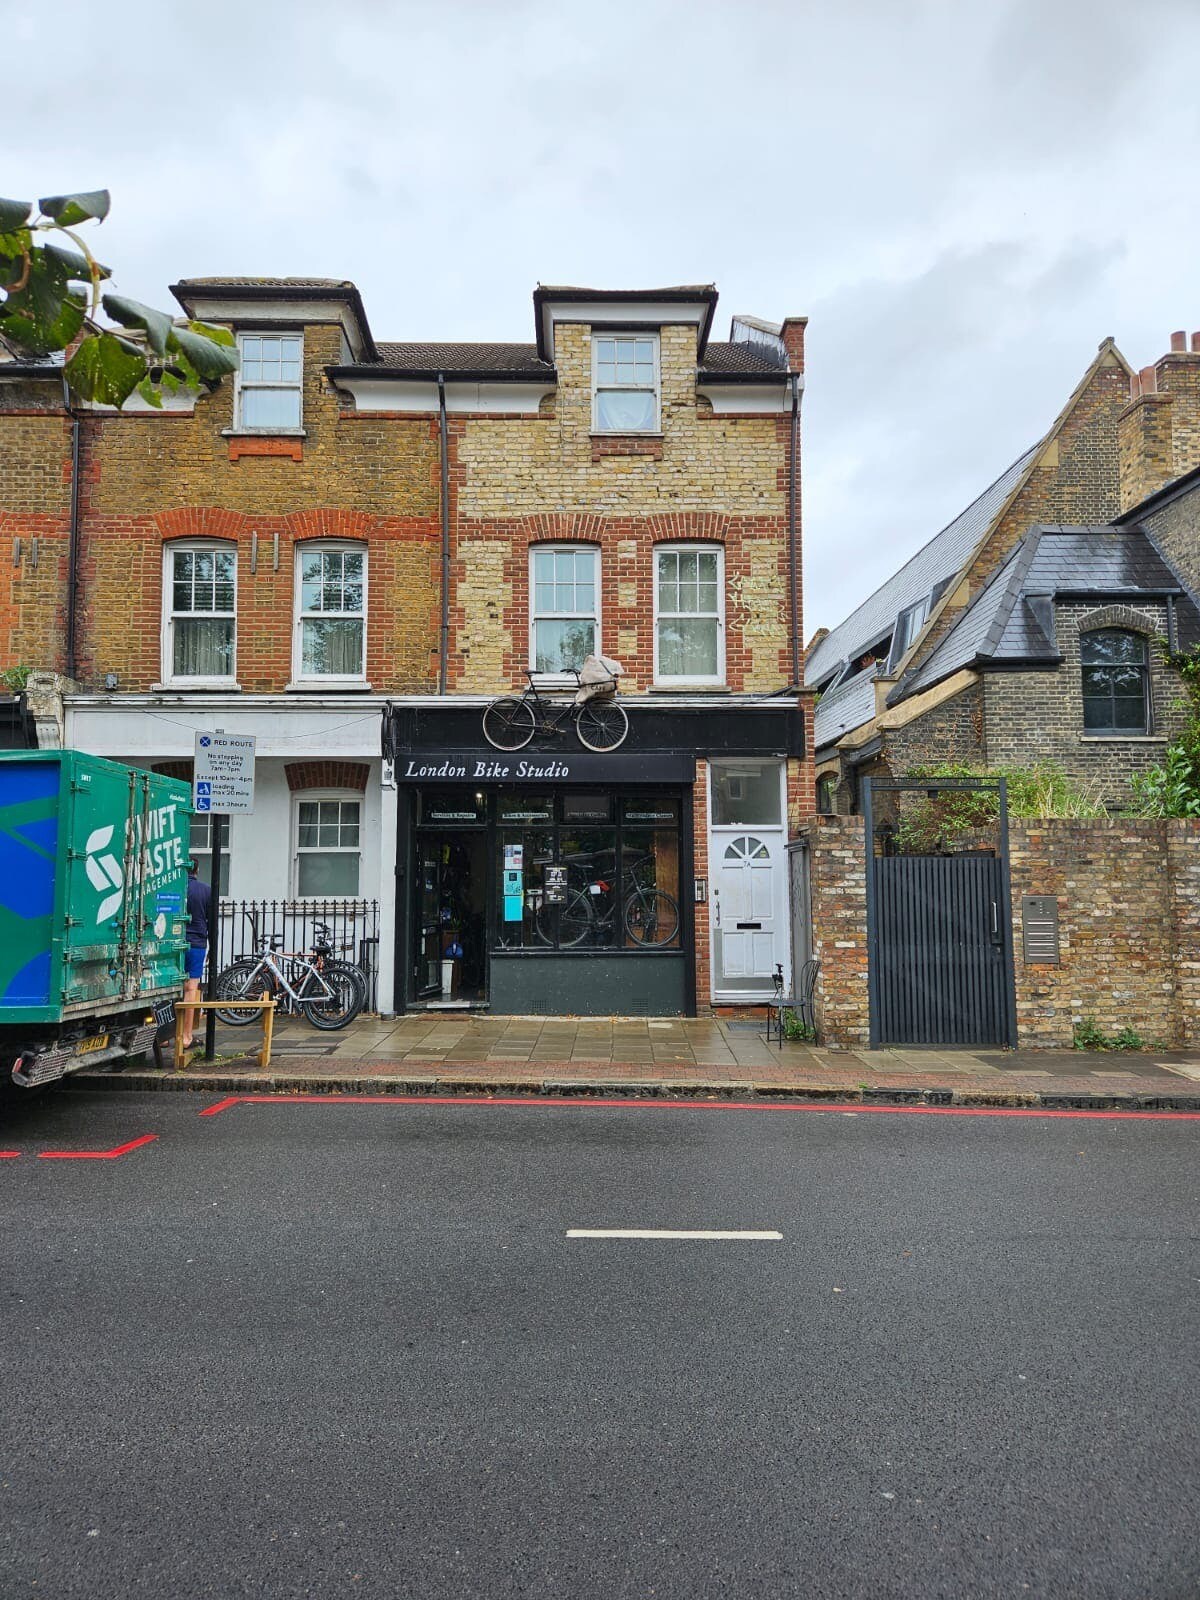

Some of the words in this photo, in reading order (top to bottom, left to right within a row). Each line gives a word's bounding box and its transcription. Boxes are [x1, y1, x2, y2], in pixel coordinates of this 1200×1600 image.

[405, 761, 466, 777] London
[473, 761, 510, 777] Bike
[516, 761, 569, 777] Studio
[124, 804, 177, 850] SWIFT
[122, 837, 182, 888] WASTE
